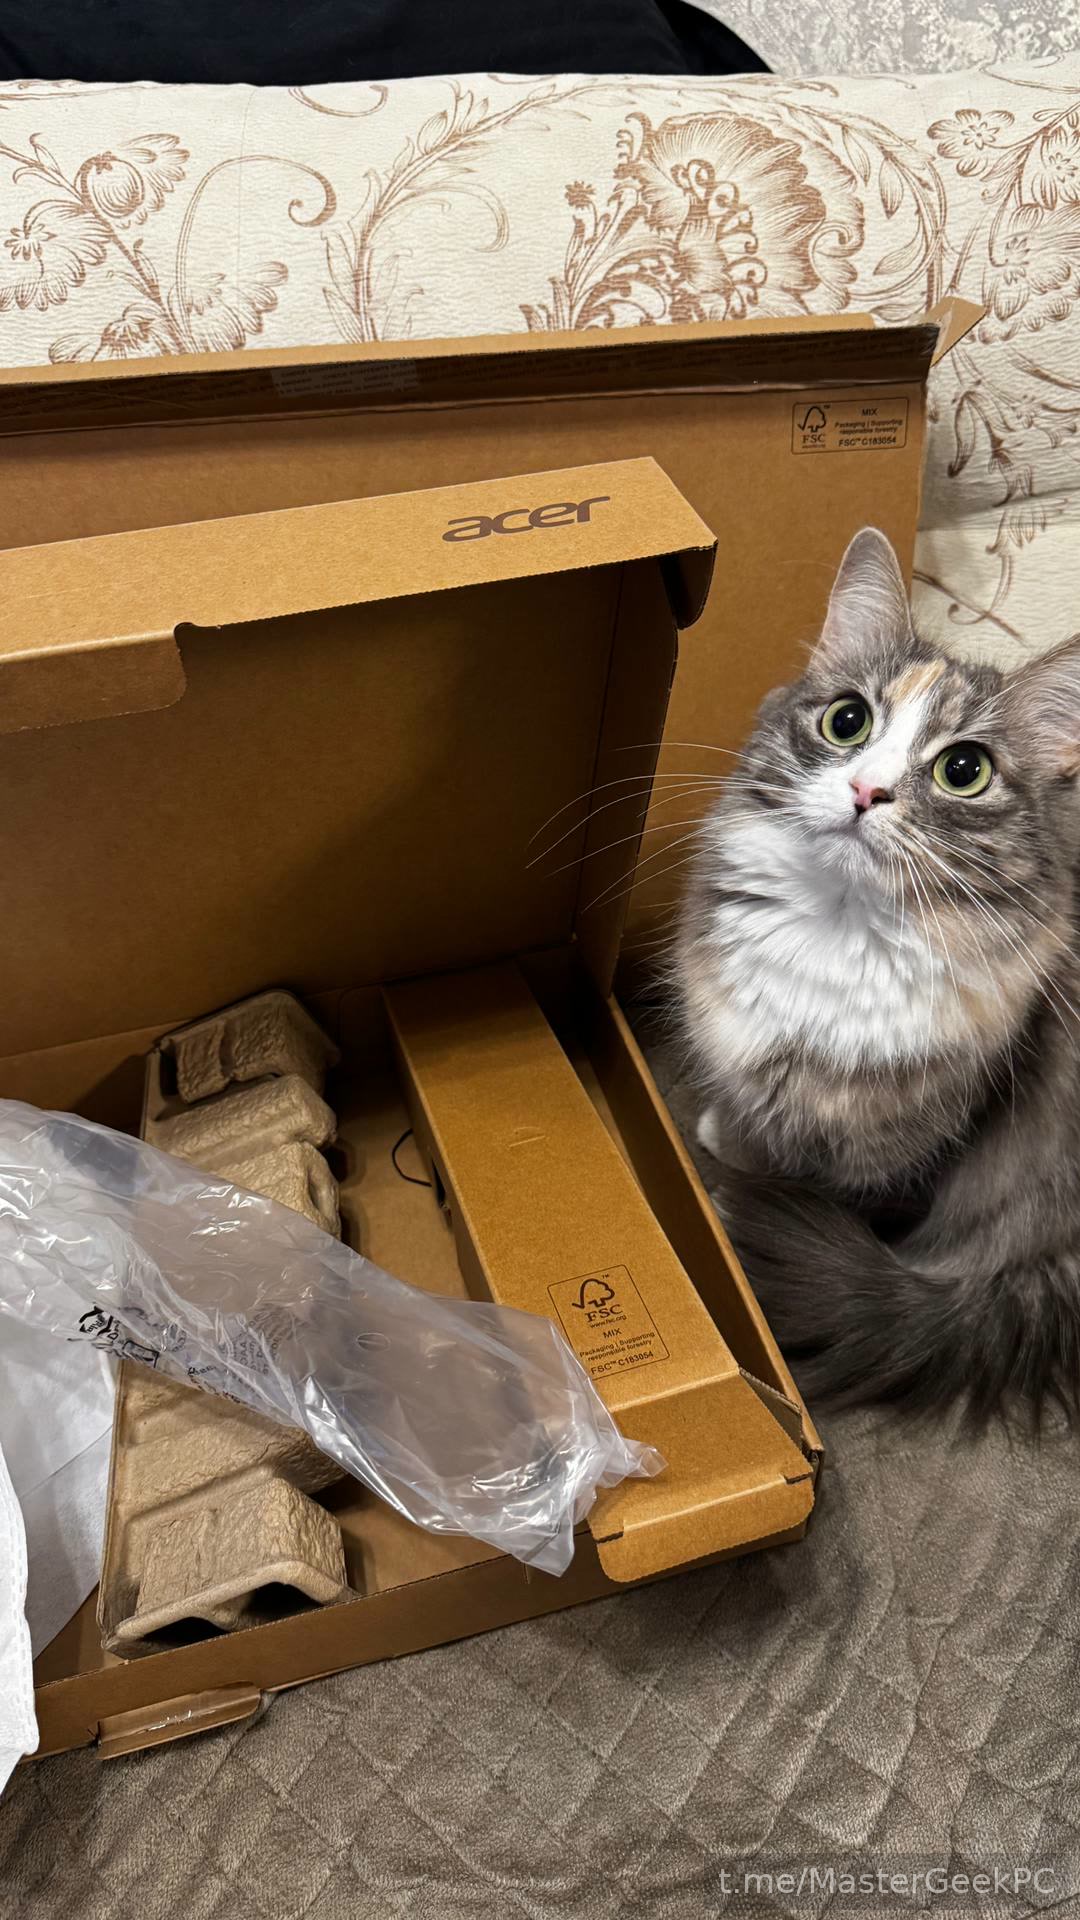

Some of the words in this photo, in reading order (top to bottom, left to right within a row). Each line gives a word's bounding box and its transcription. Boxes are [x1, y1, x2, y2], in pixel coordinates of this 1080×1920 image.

[862, 408, 878, 416] MIX
[802, 433, 826, 444] FSC
[862, 436, 897, 446] C183054
[442, 496, 611, 542] acer
[585, 1304, 623, 1322] FSC
[589, 1314, 627, 1328] www.fsc.org
[603, 1328, 622, 1339] MIX
[579, 1343, 615, 1358] Packaging
[619, 1331, 655, 1346] Supporting
[588, 1347, 626, 1361] responsible
[627, 1339, 652, 1351] forestry
[618, 1351, 654, 1366] C183054
